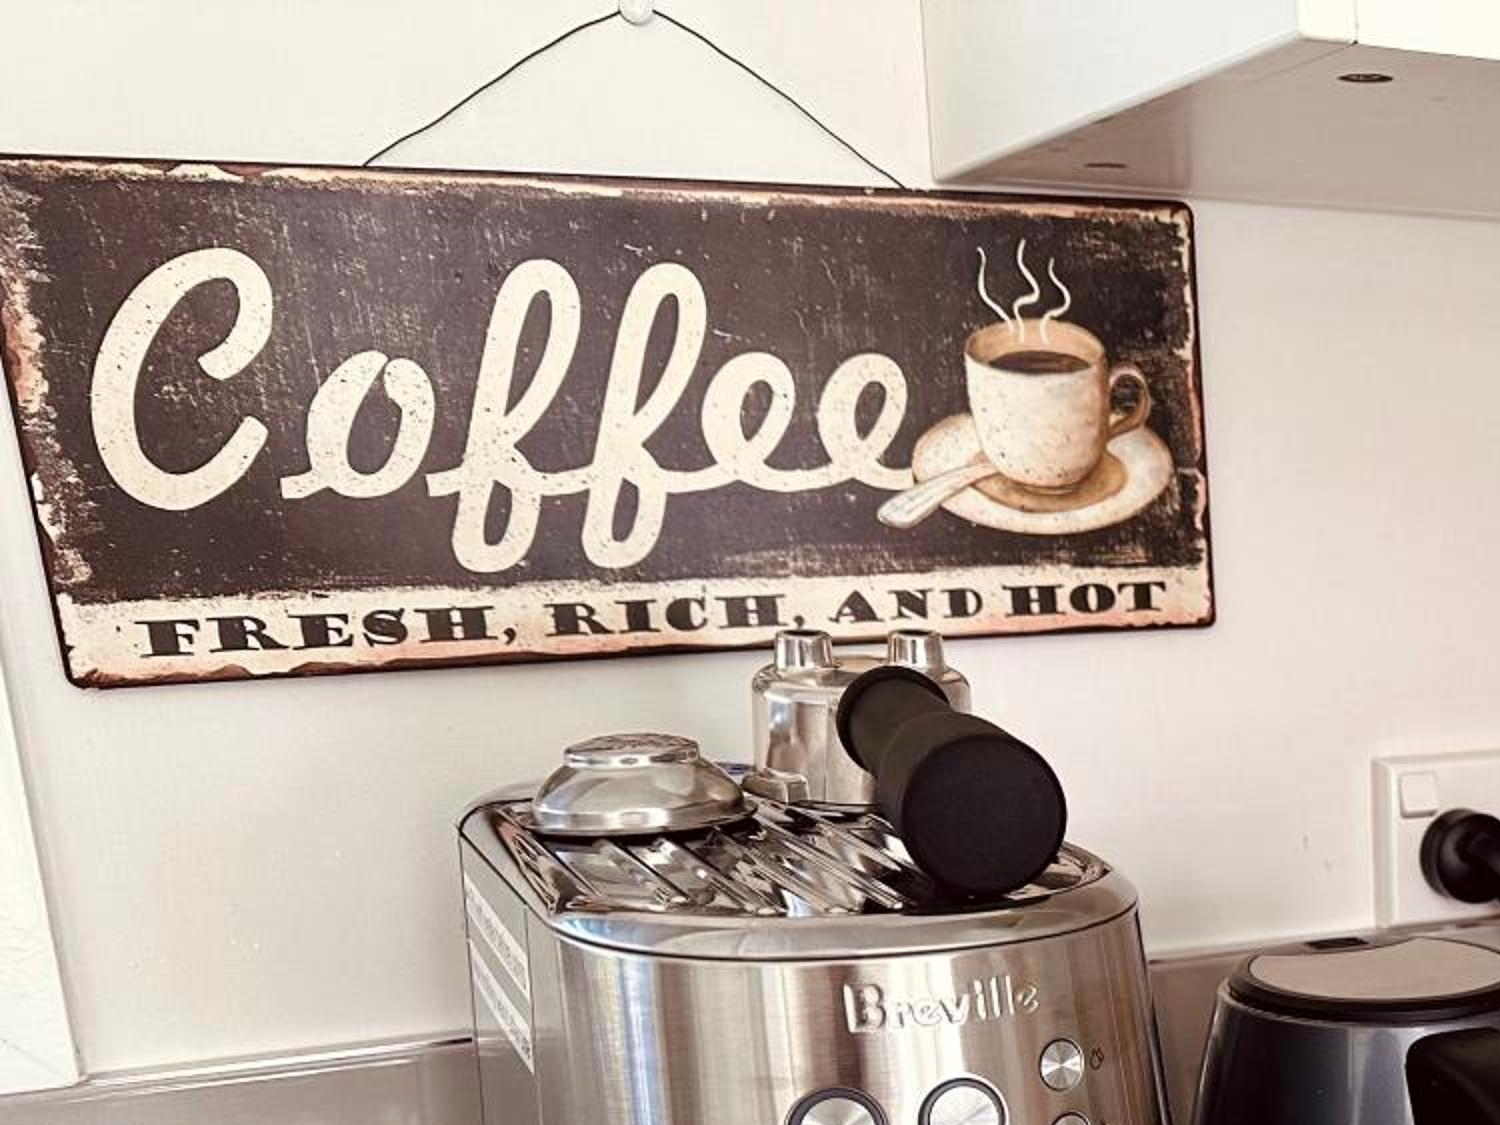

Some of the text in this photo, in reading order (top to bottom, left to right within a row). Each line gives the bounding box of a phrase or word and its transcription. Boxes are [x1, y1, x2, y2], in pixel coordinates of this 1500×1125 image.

[90, 247, 915, 573] Coffee
[135, 606, 517, 658] FRESH,
[829, 587, 985, 624] AND
[1001, 580, 1167, 617] HOT
[843, 974, 1040, 1033] Breville
